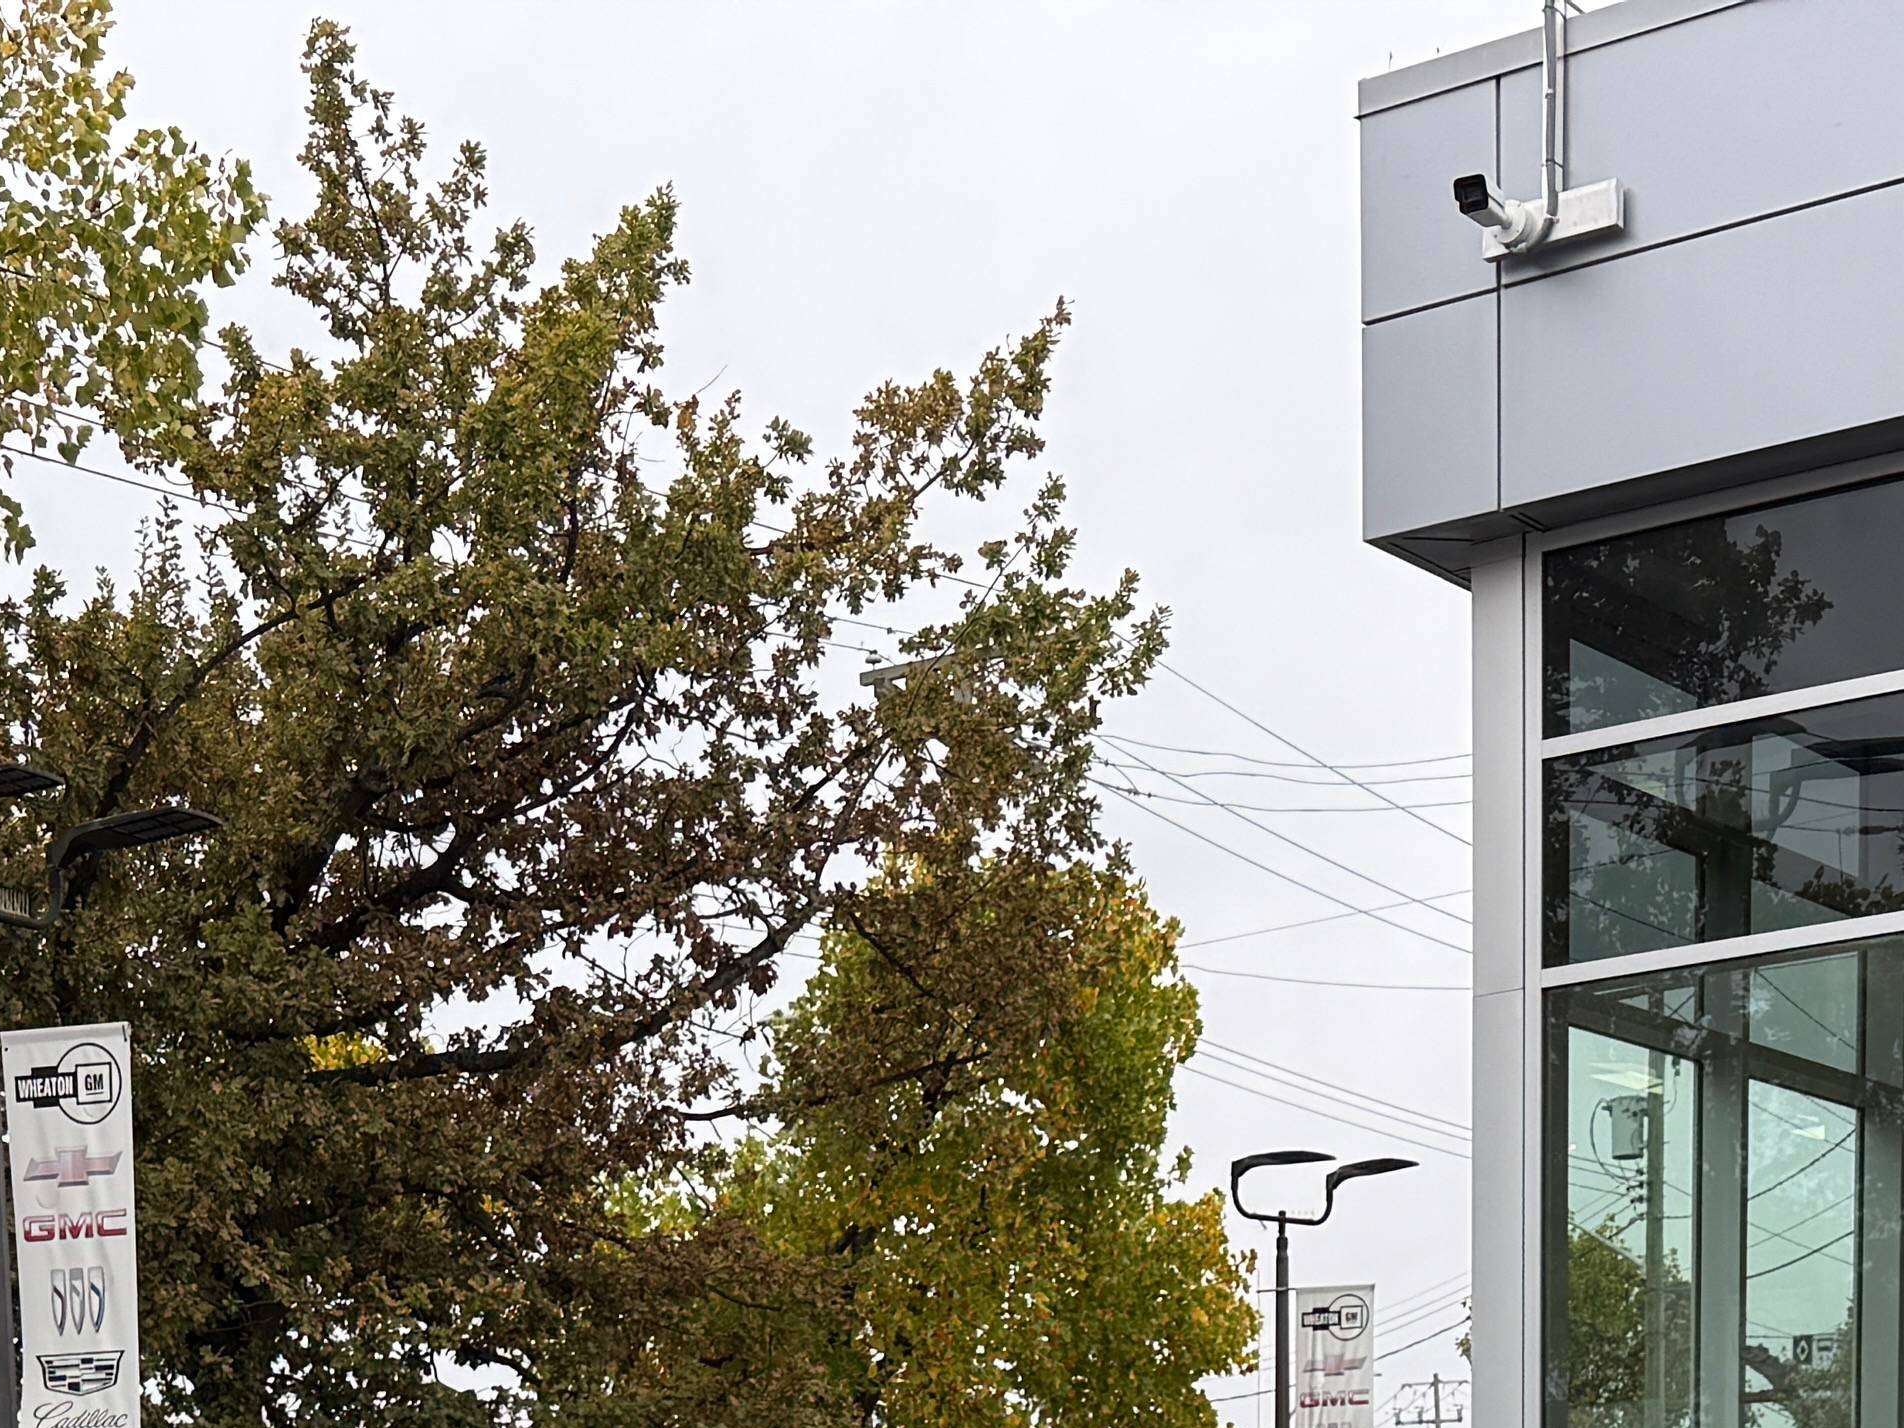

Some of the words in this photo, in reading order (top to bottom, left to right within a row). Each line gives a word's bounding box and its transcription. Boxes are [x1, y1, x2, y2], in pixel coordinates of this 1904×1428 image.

[17, 1074, 74, 1100] WHEATON
[84, 1074, 104, 1093] GM
[23, 1208, 128, 1243] GMC
[1300, 1389, 1369, 1408] GMC
